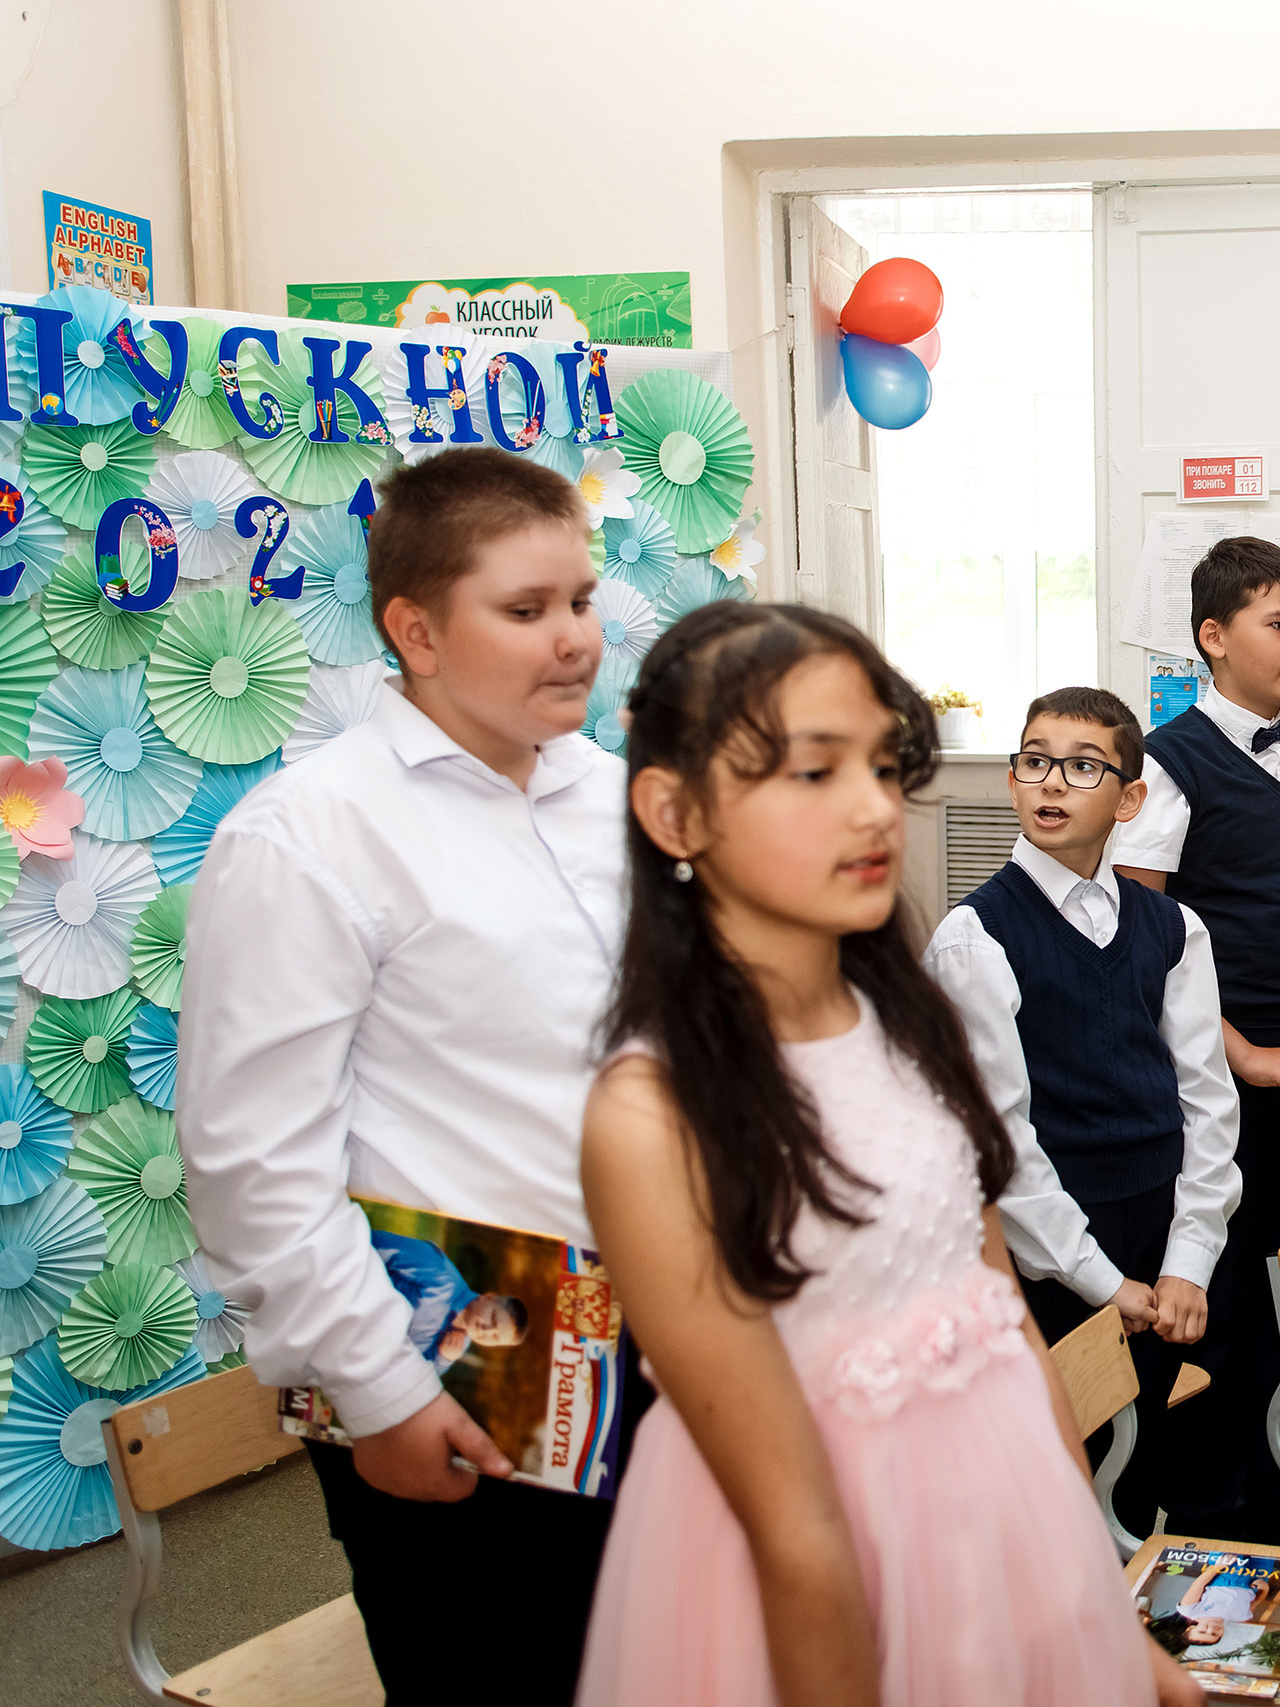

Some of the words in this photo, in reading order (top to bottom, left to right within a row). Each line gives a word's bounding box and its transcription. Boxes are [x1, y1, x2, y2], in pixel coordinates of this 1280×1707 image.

[61, 203, 137, 242] ENGLISH
[55, 226, 145, 264] ALPHABET
[75, 257, 84, 273] B
[94, 262, 103, 278] C
[113, 266, 122, 282] D
[131, 270, 140, 286] E
[456, 295, 553, 322] КЛАССНЫЙ
[1186, 466, 1201, 476] ПРИ
[1202, 465, 1233, 476] ПОЖАРЕ
[1242, 464, 1255, 475] 01
[1192, 479, 1226, 490] ЗВОНИТЬ
[1239, 482, 1257, 492] 112
[550, 1340, 585, 1469] Грамота
[1167, 1551, 1250, 1566] АЛЬБОМ
